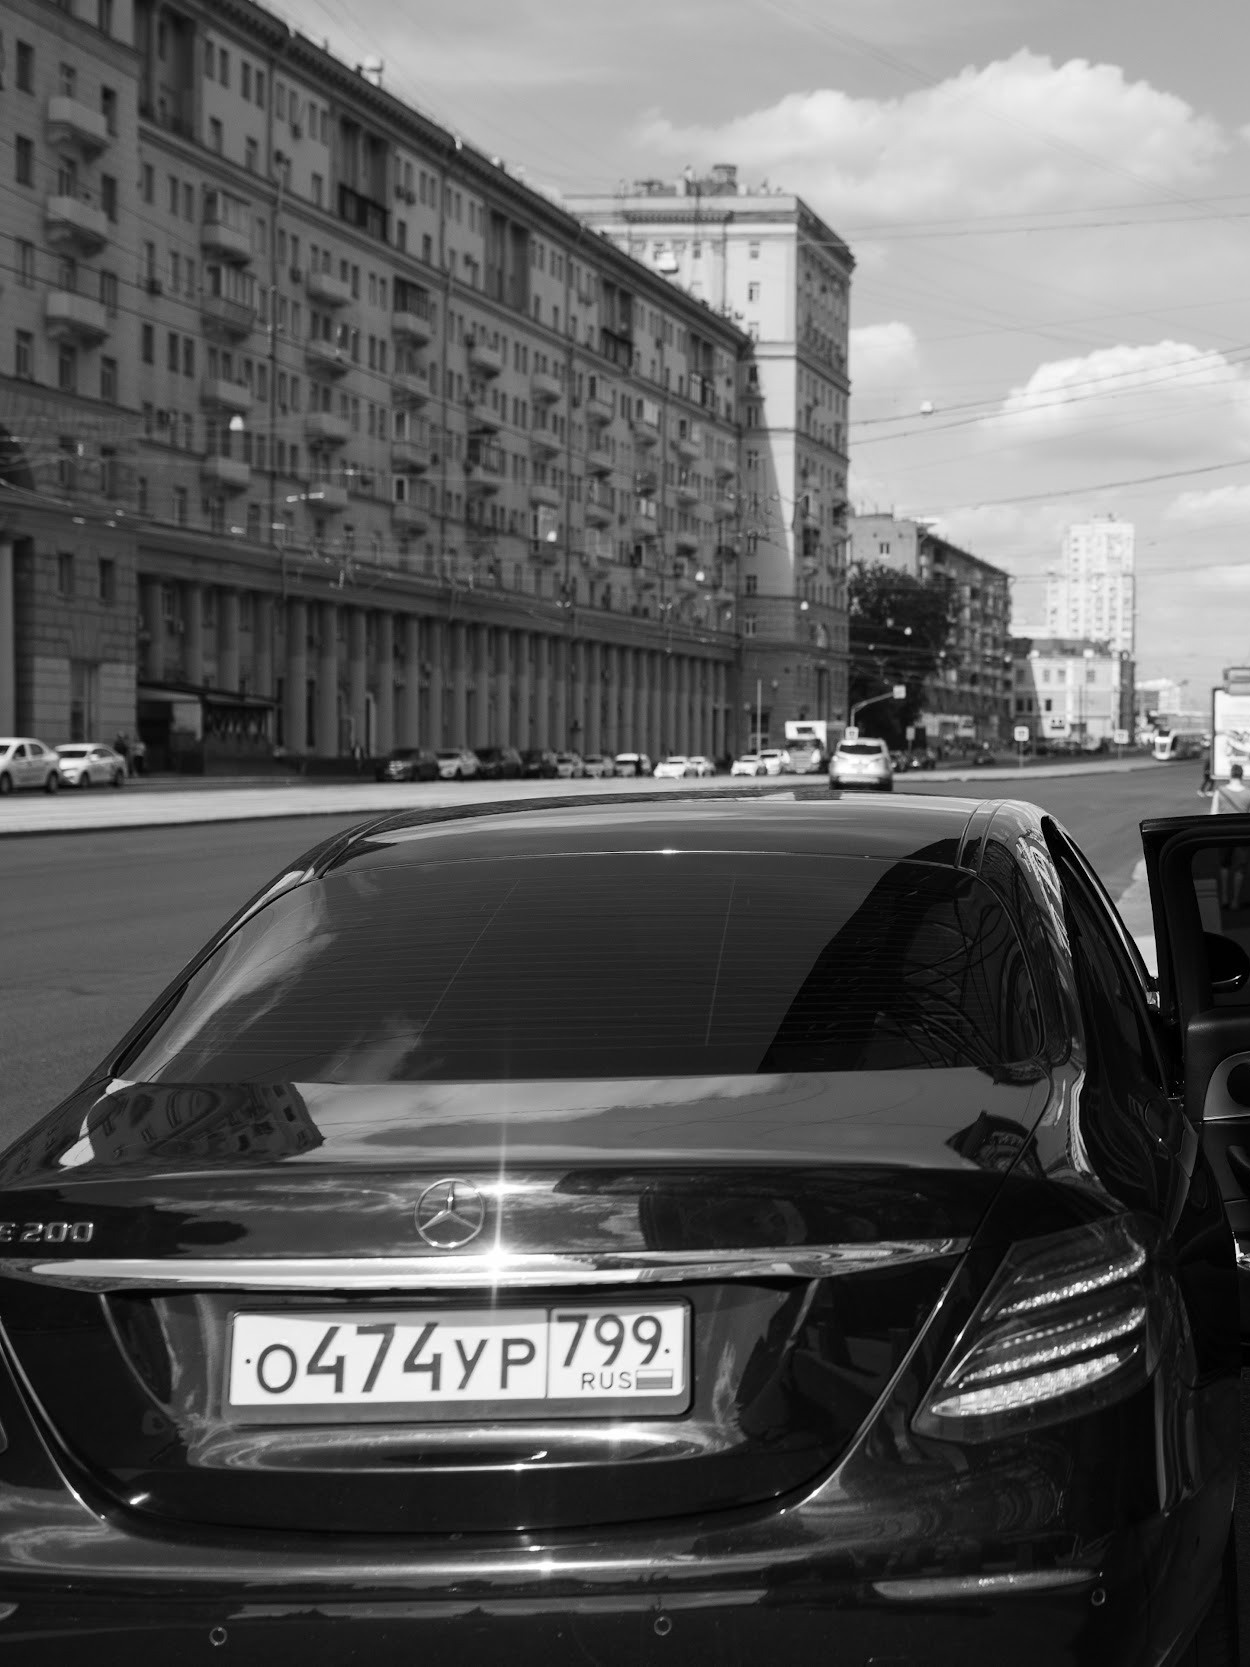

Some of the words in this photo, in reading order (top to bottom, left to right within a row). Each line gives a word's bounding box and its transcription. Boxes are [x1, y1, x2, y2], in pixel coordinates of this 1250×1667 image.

[20, 1222, 94, 1242] 200
[557, 1313, 663, 1368] 799
[581, 1371, 633, 1391] RUS
